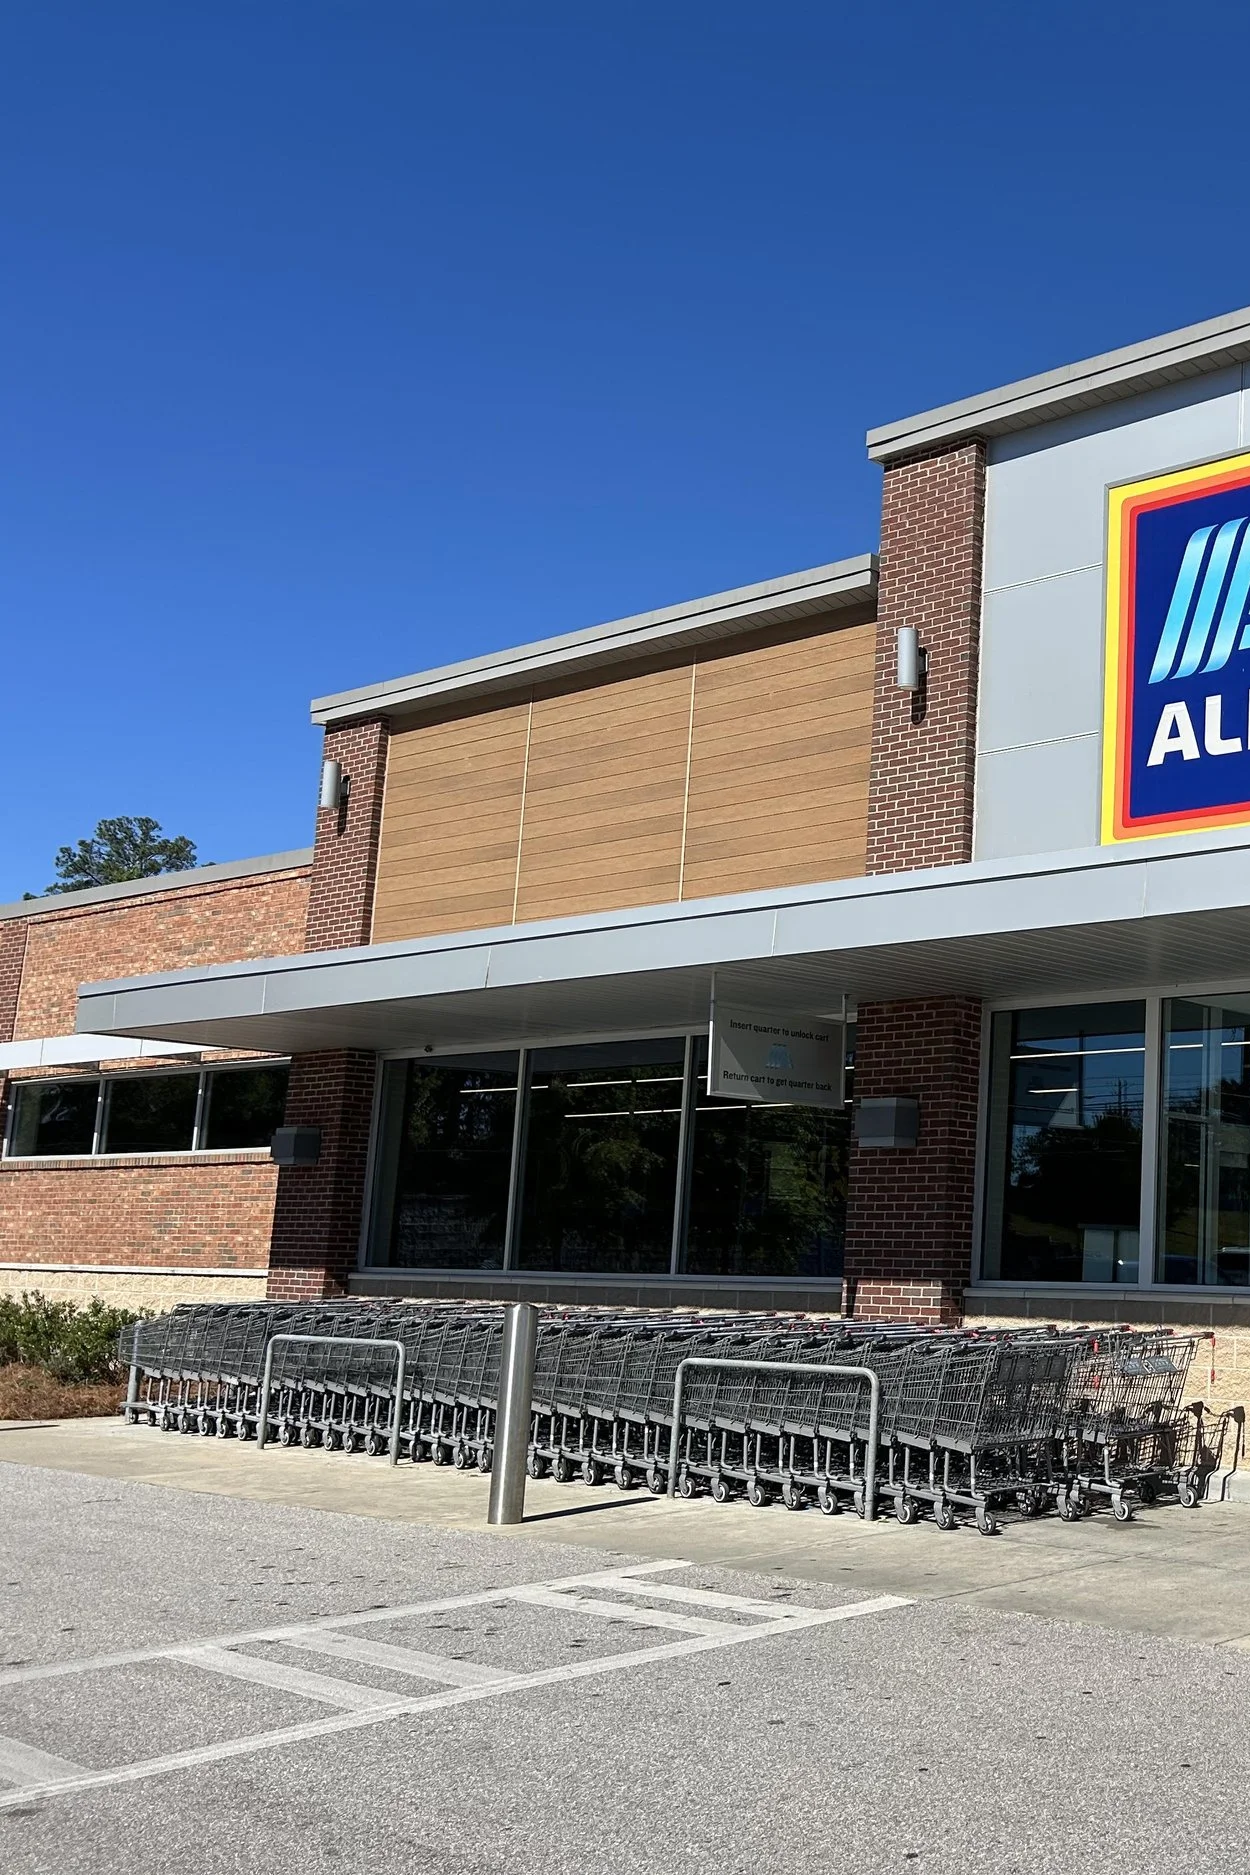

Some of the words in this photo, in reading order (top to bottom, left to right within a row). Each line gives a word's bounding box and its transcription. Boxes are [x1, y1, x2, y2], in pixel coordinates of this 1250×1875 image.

[730, 1019, 752, 1031] Insert
[754, 1024, 780, 1036] quarter
[782, 1027, 790, 1036] to
[791, 1030, 814, 1041] unlock
[815, 1033, 830, 1042] cart
[723, 1070, 749, 1081] Return
[750, 1074, 765, 1083] cart
[767, 1076, 775, 1085] to
[776, 1078, 787, 1088] get
[789, 1079, 814, 1090] quarter
[815, 1081, 832, 1092] back
